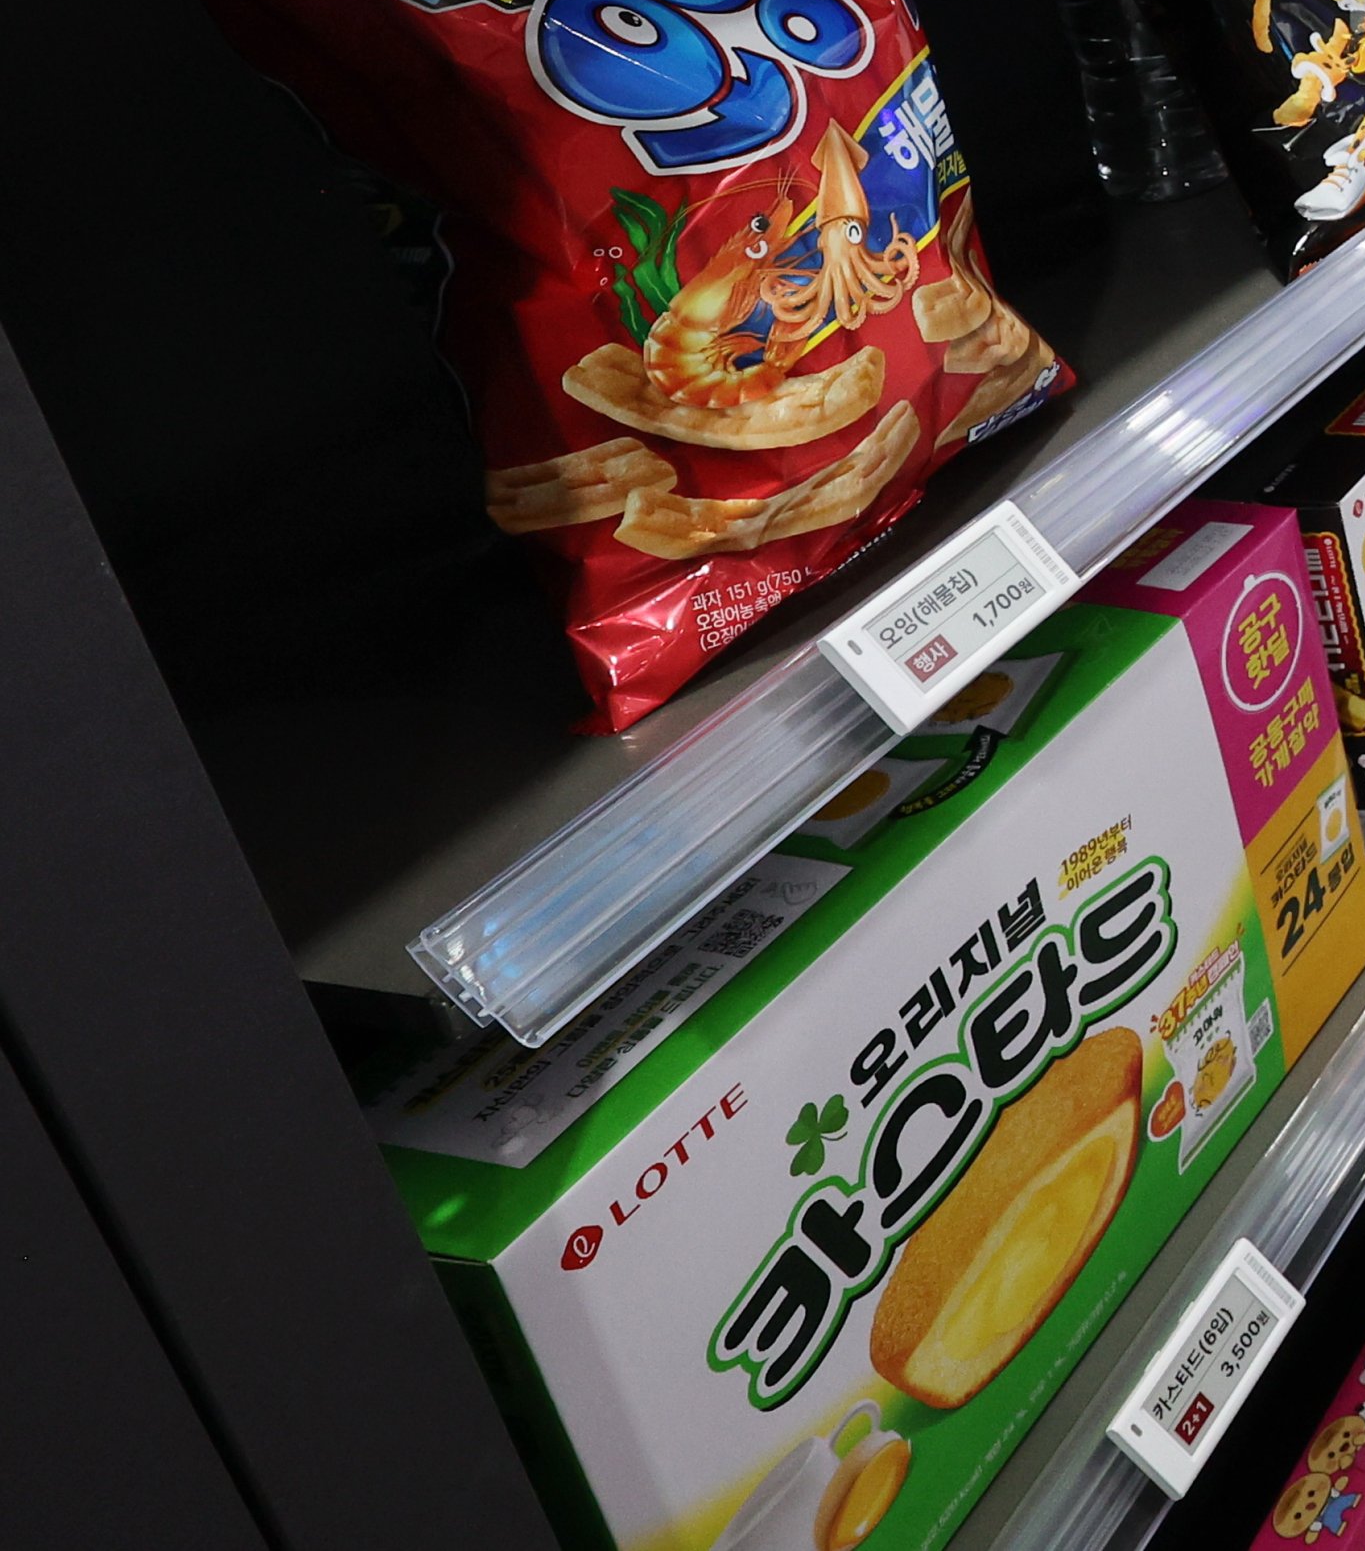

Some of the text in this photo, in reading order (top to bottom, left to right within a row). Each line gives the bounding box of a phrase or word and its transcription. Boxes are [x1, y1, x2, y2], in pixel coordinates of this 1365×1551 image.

[878, 59, 955, 171] 해물
[691, 590, 722, 613] 과자
[727, 581, 753, 602] 151
[878, 568, 980, 650] 오잉(해물칩)
[912, 577, 1037, 674] 행사 1,700원
[1236, 593, 1284, 647] 공구
[1243, 625, 1291, 691] 핫딜
[1247, 676, 1317, 766] 공동구매
[1060, 813, 1132, 876] 1989년부터
[1066, 855, 1102, 891] 이어온
[848, 874, 1051, 1110] 오리지널
[605, 1079, 757, 1231] LOTTE
[725, 872, 1168, 1399] 카스타드
[1151, 1306, 1235, 1421] 카스타드(6입)
[1180, 1308, 1271, 1438] 2+1 3,500원
